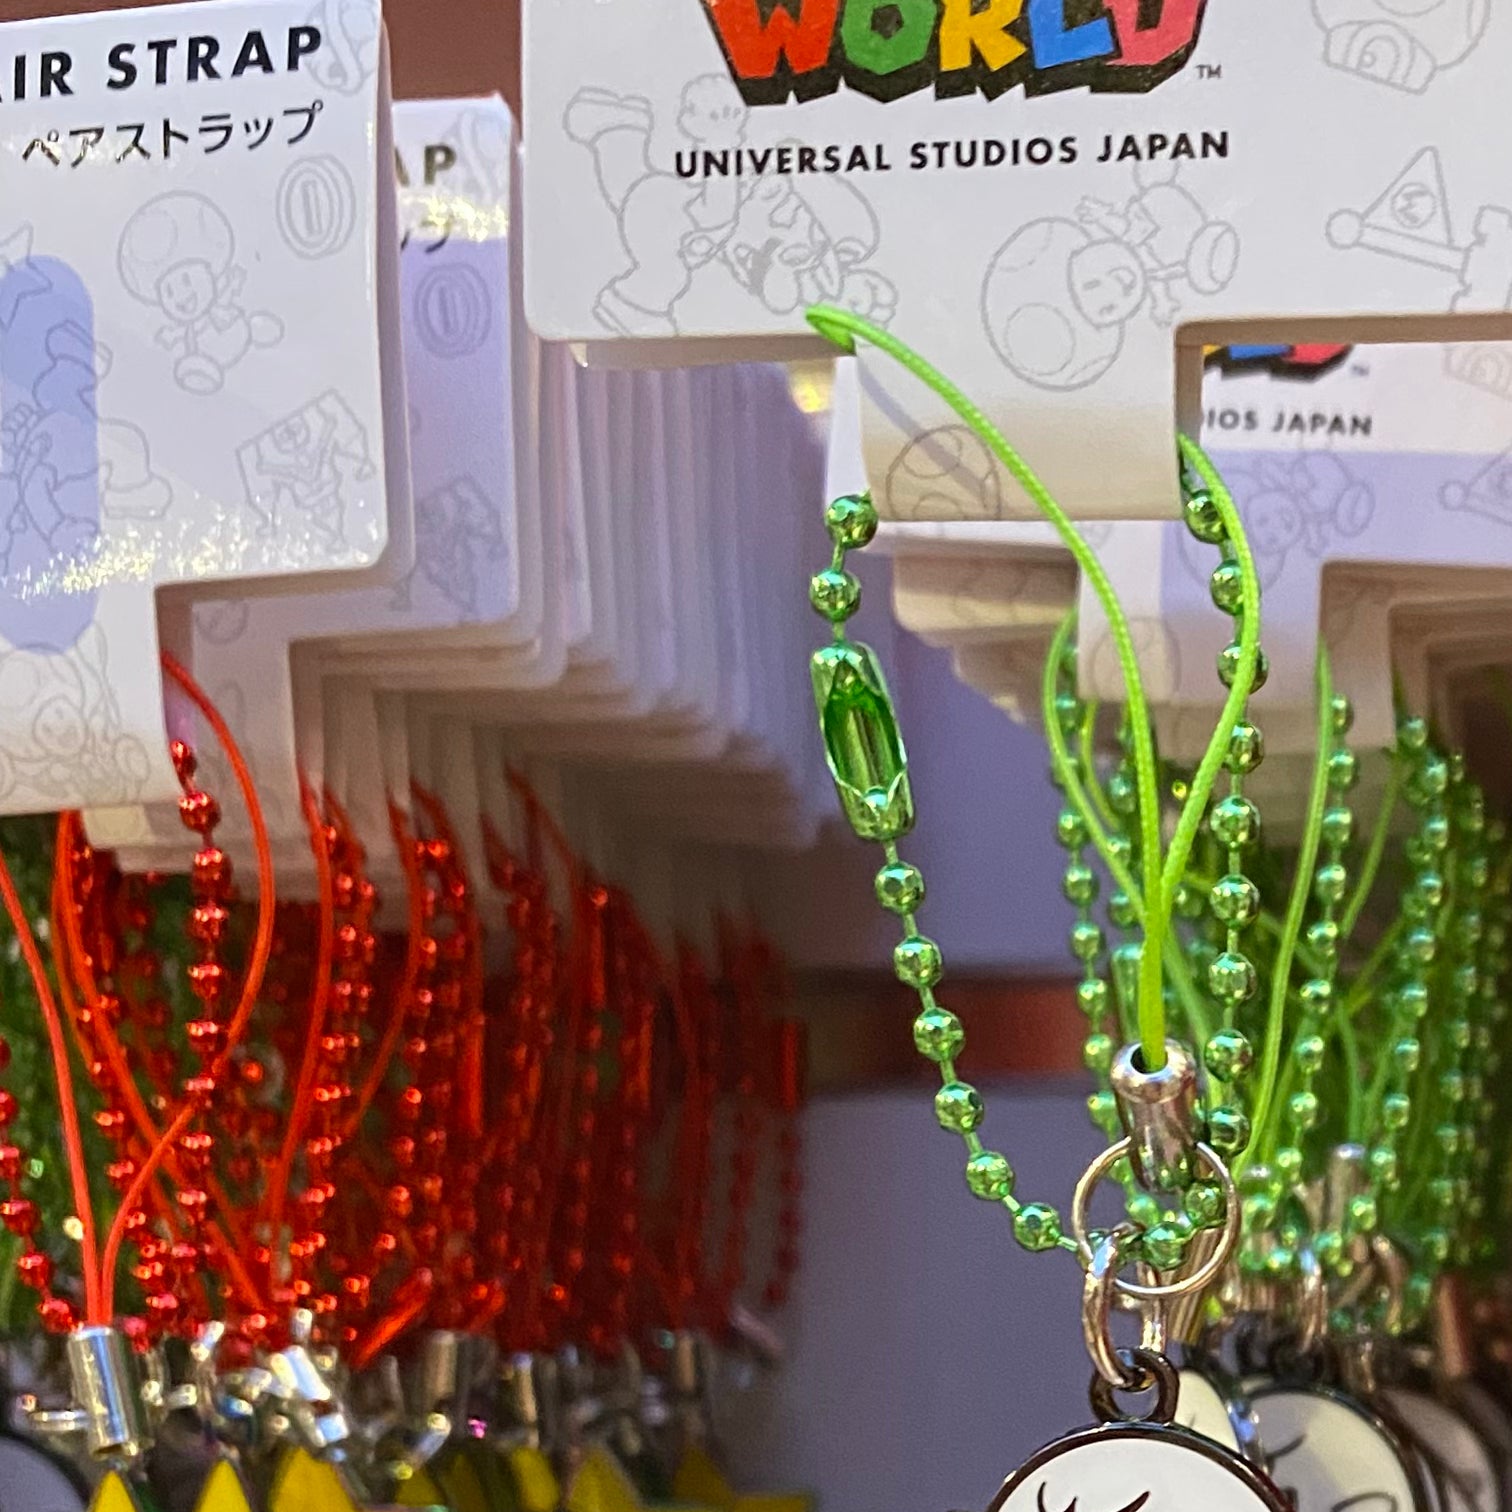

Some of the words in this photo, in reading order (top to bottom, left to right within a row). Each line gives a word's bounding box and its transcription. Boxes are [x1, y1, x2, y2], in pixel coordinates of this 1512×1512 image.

[0, 50, 74, 101] IR
[106, 25, 322, 91] STRAP
[700, 0, 1208, 106] WORLD
[22, 99, 324, 168] ペアストラップ
[675, 144, 892, 178] UNIVERSAL
[909, 136, 1078, 169] STUDIOS
[1097, 131, 1230, 163] JAPAN
[1271, 410, 1373, 437] JAPAN
